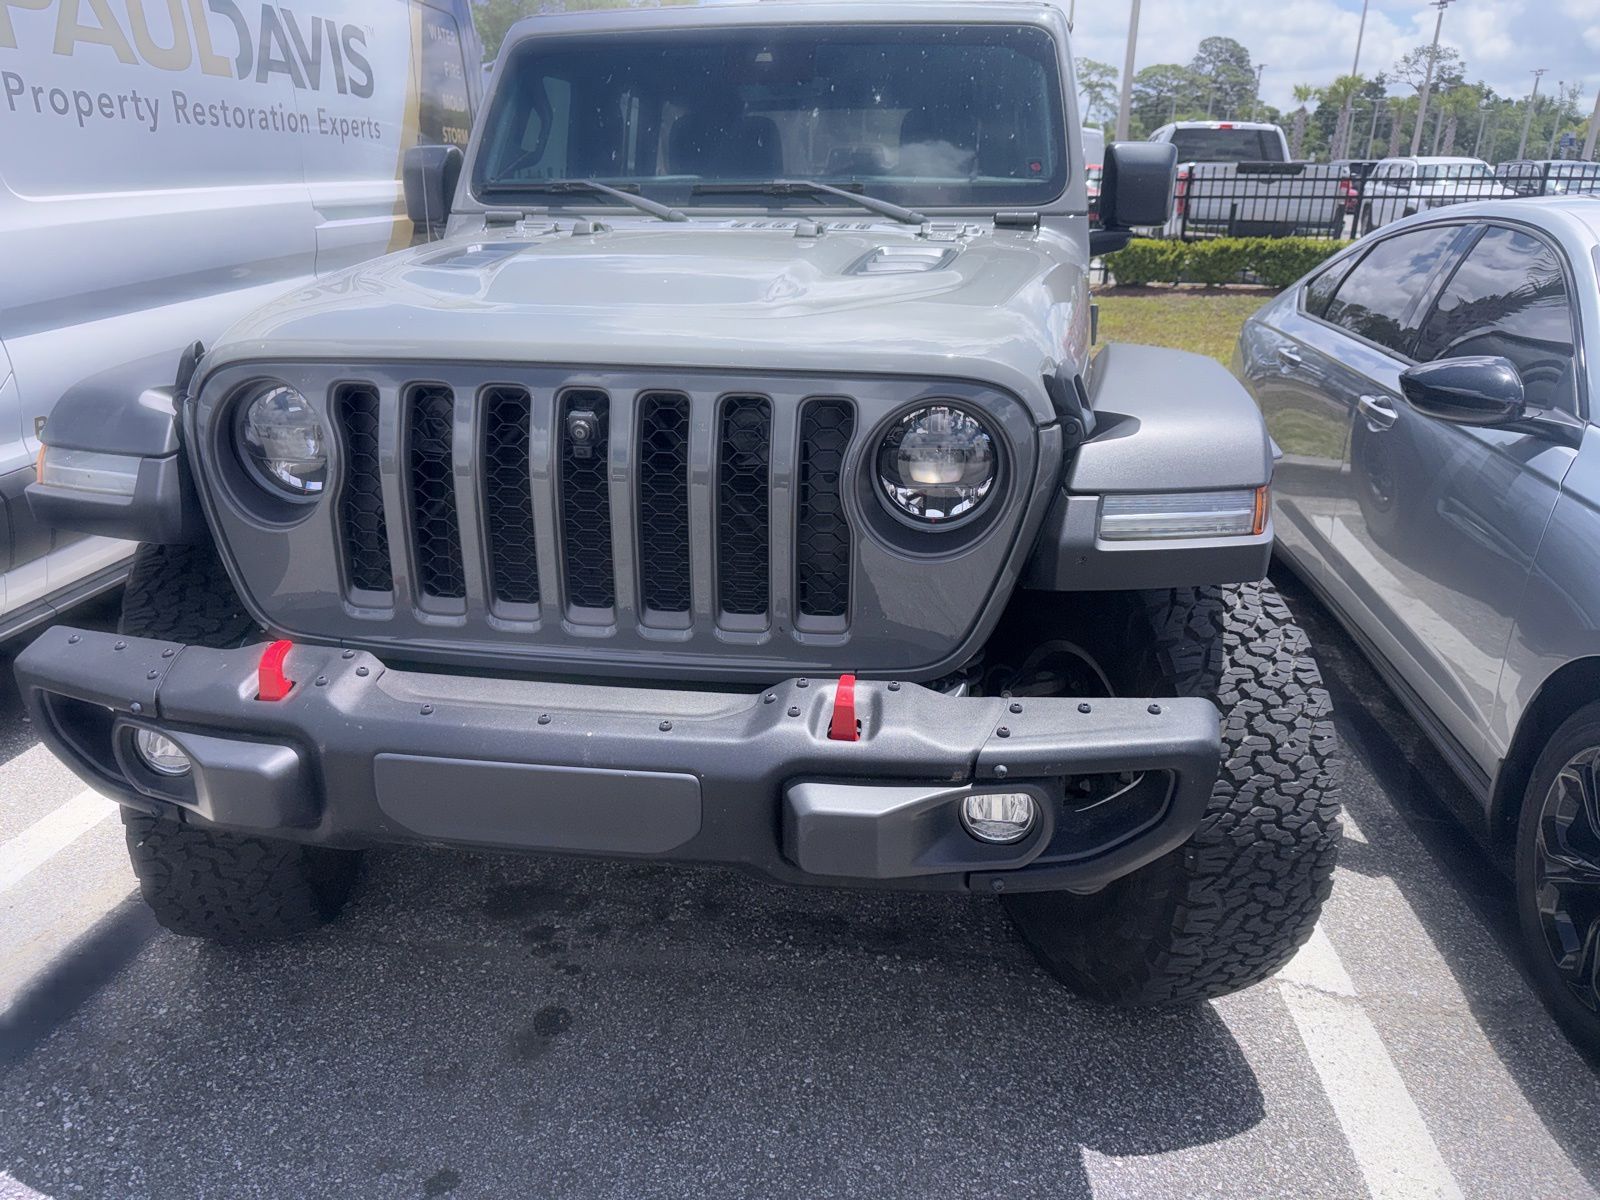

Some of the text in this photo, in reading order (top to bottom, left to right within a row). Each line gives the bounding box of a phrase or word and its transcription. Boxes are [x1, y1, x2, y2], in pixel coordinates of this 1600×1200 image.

[207, 0, 375, 99] DAVIS
[1, 71, 381, 144] Property Restoration Experts
[442, 126, 469, 145] STORM
